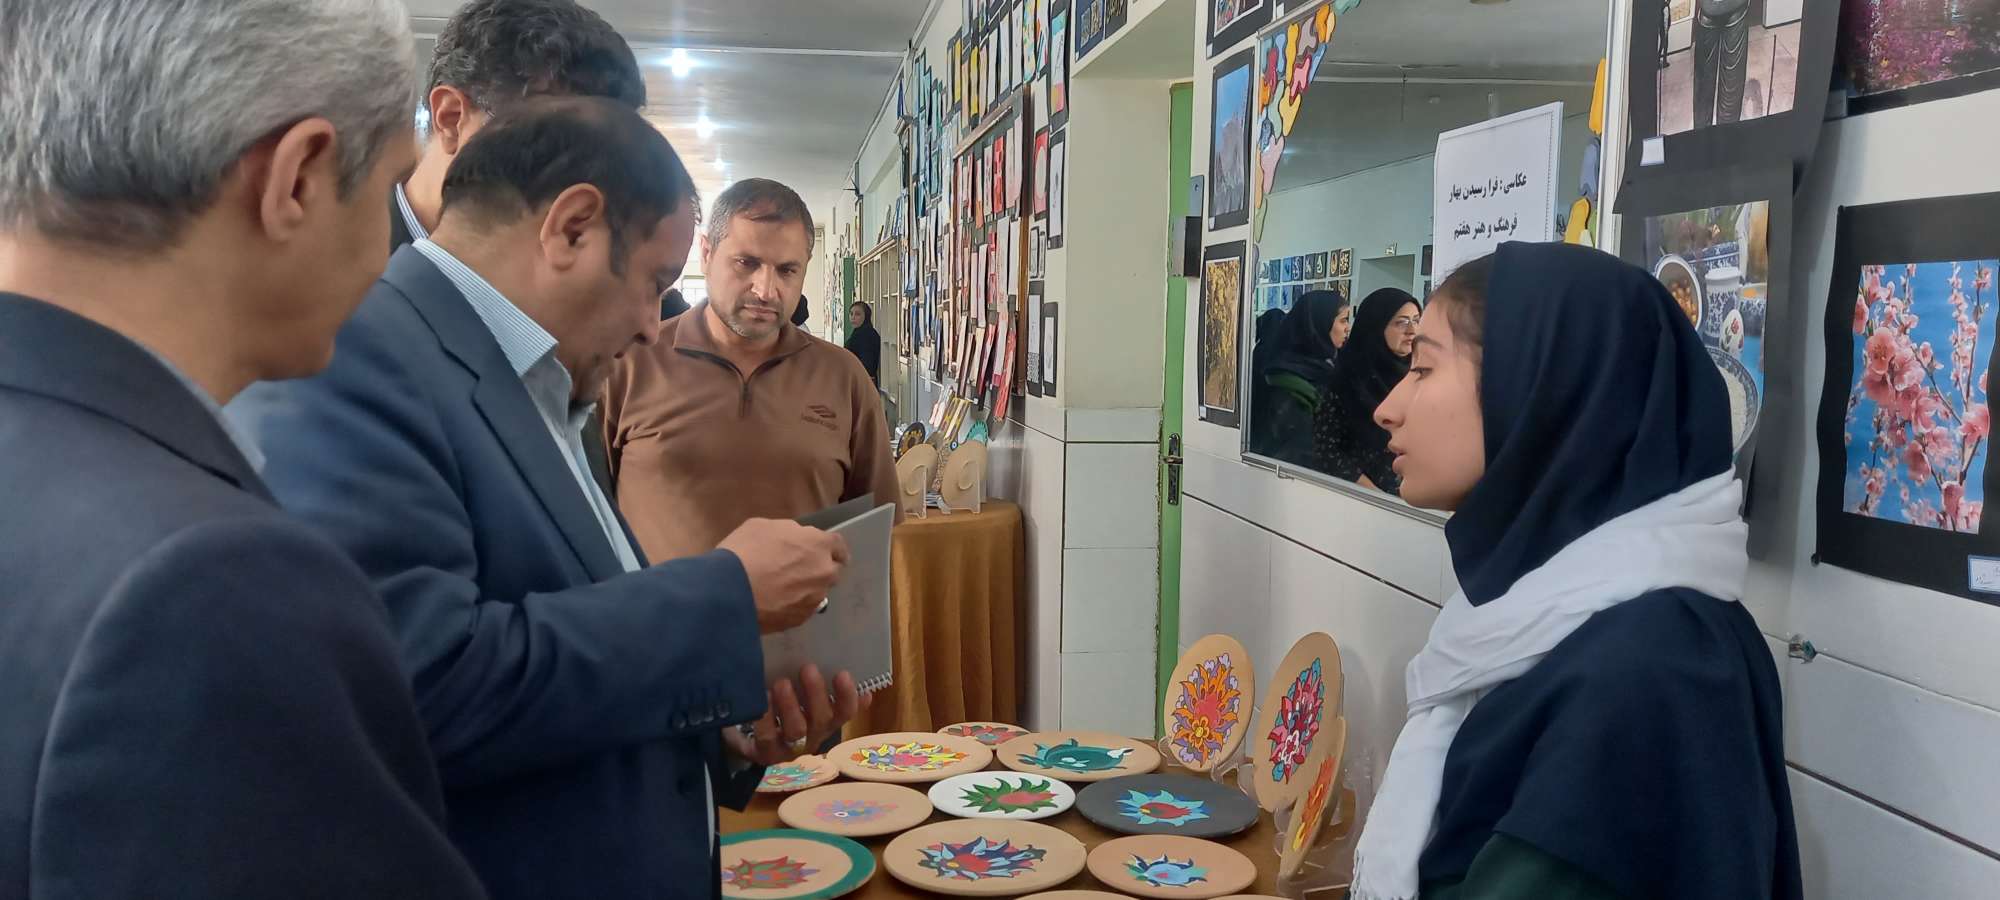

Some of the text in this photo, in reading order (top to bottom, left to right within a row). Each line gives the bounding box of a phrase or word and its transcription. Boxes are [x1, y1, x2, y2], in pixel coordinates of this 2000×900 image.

[1448, 184, 1462, 203] بهار
[1462, 184, 1487, 200] رسیدن
[1488, 176, 1498, 197] فرا
[1454, 213, 1518, 241] فرهنگ و هنر هفتم
